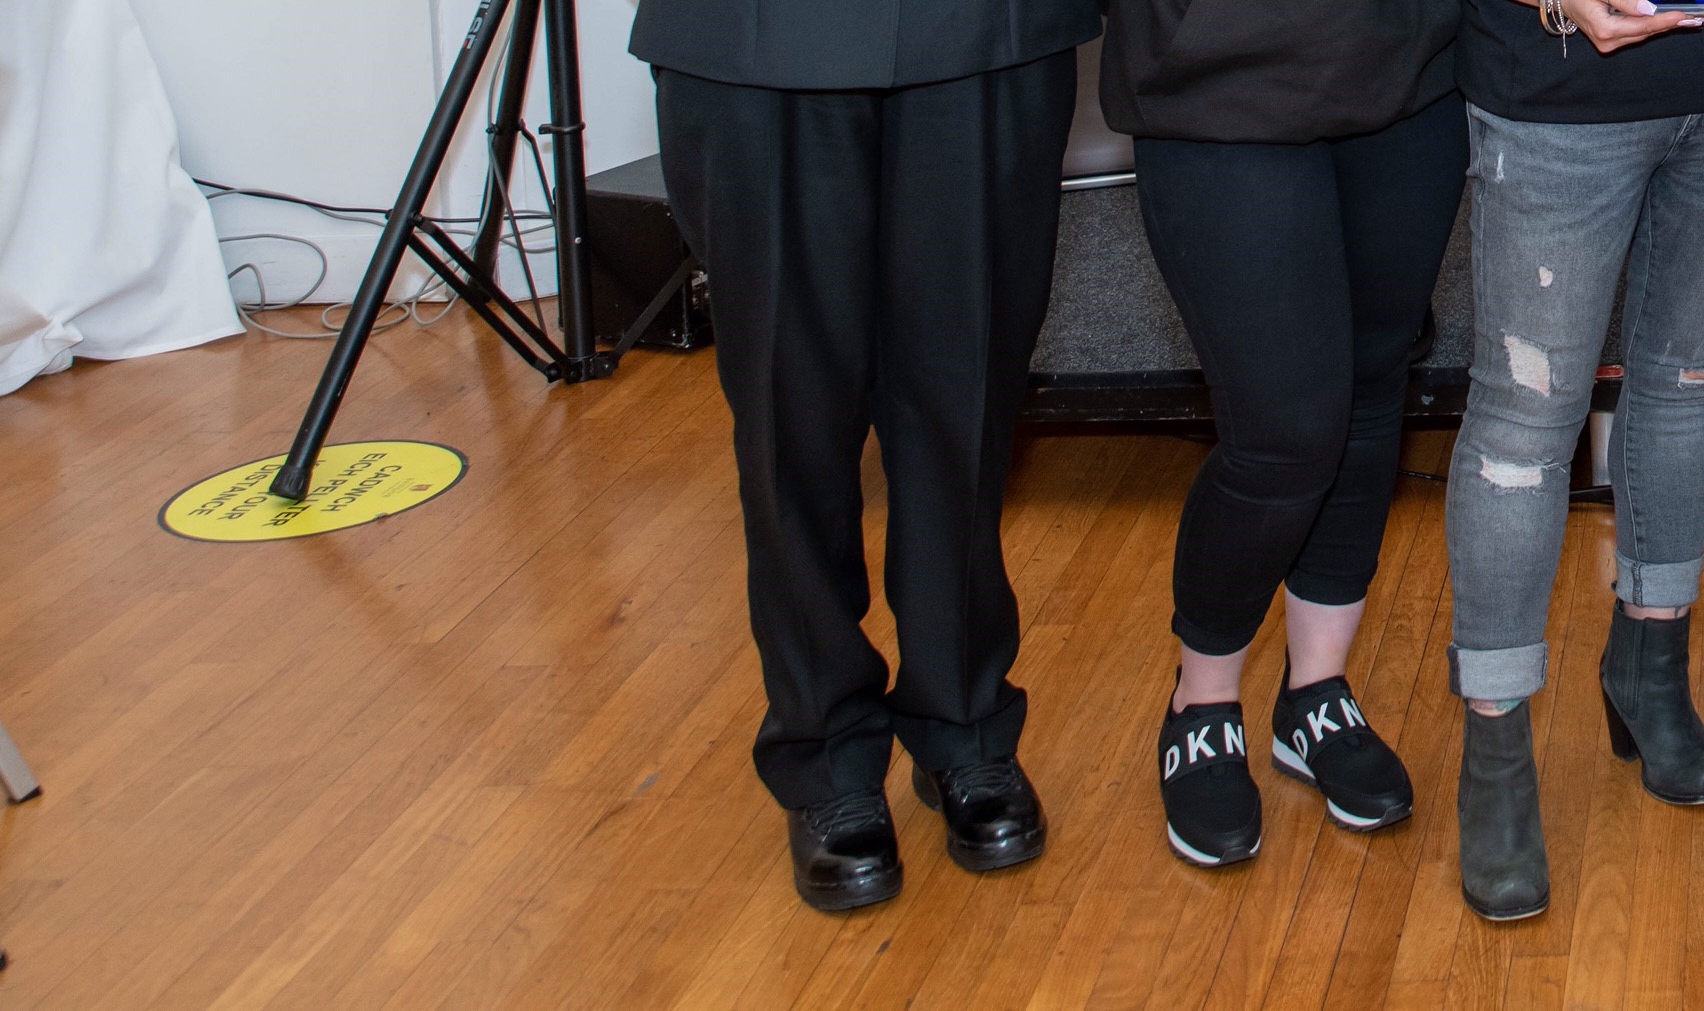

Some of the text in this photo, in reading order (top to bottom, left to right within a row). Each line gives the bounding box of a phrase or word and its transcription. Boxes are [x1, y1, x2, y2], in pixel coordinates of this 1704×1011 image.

[338, 452, 388, 477] EICH
[187, 464, 284, 517] DISTANCE
[320, 465, 403, 512] CADWCH
